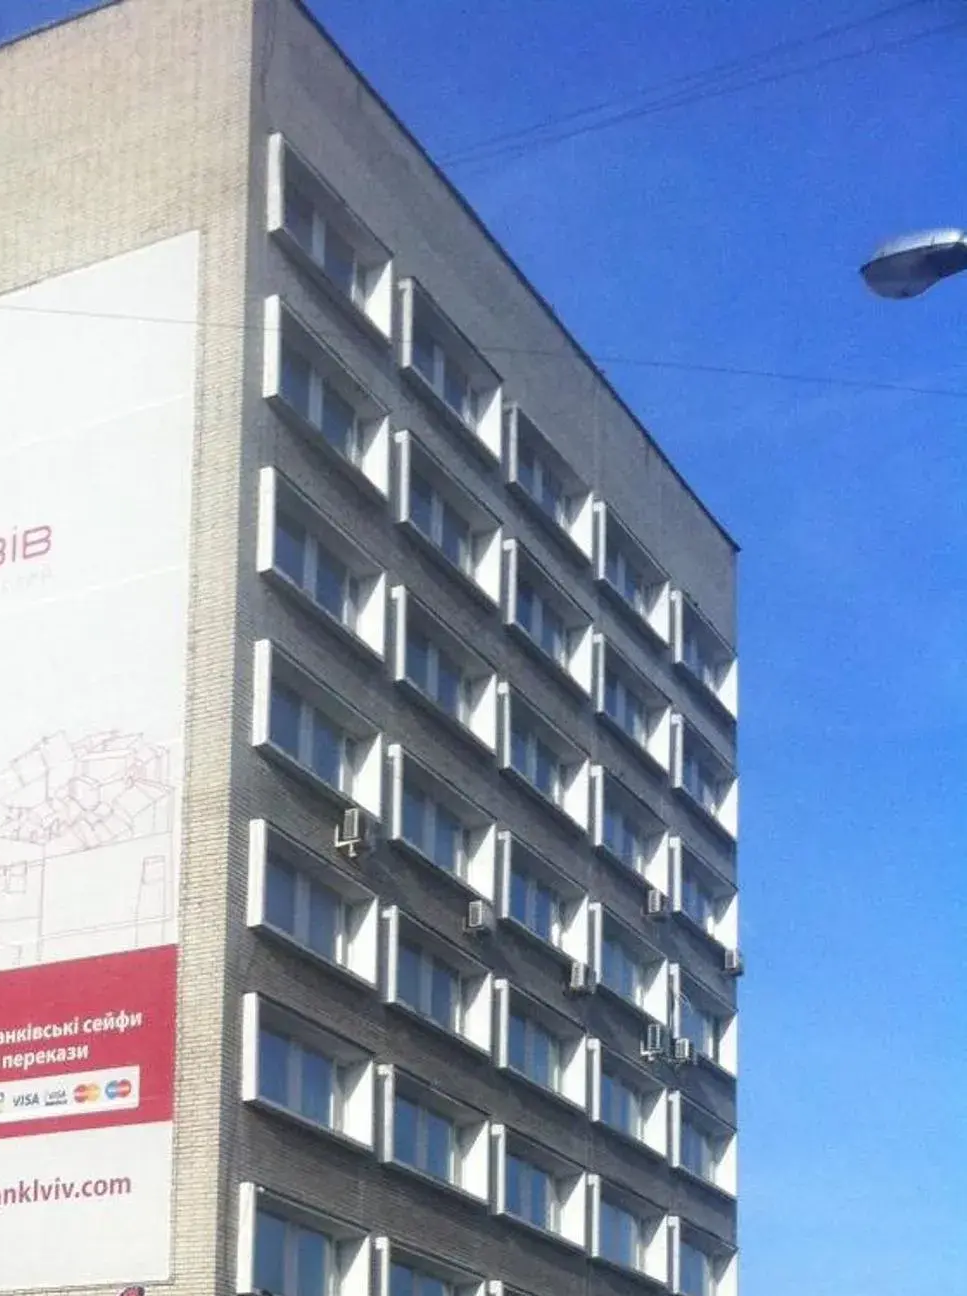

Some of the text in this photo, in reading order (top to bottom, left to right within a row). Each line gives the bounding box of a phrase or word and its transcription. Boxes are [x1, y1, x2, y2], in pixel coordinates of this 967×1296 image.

[84, 1010, 142, 1034] сейфи
[3, 1043, 89, 1070] перекази
[13, 1095, 40, 1107] VISA
